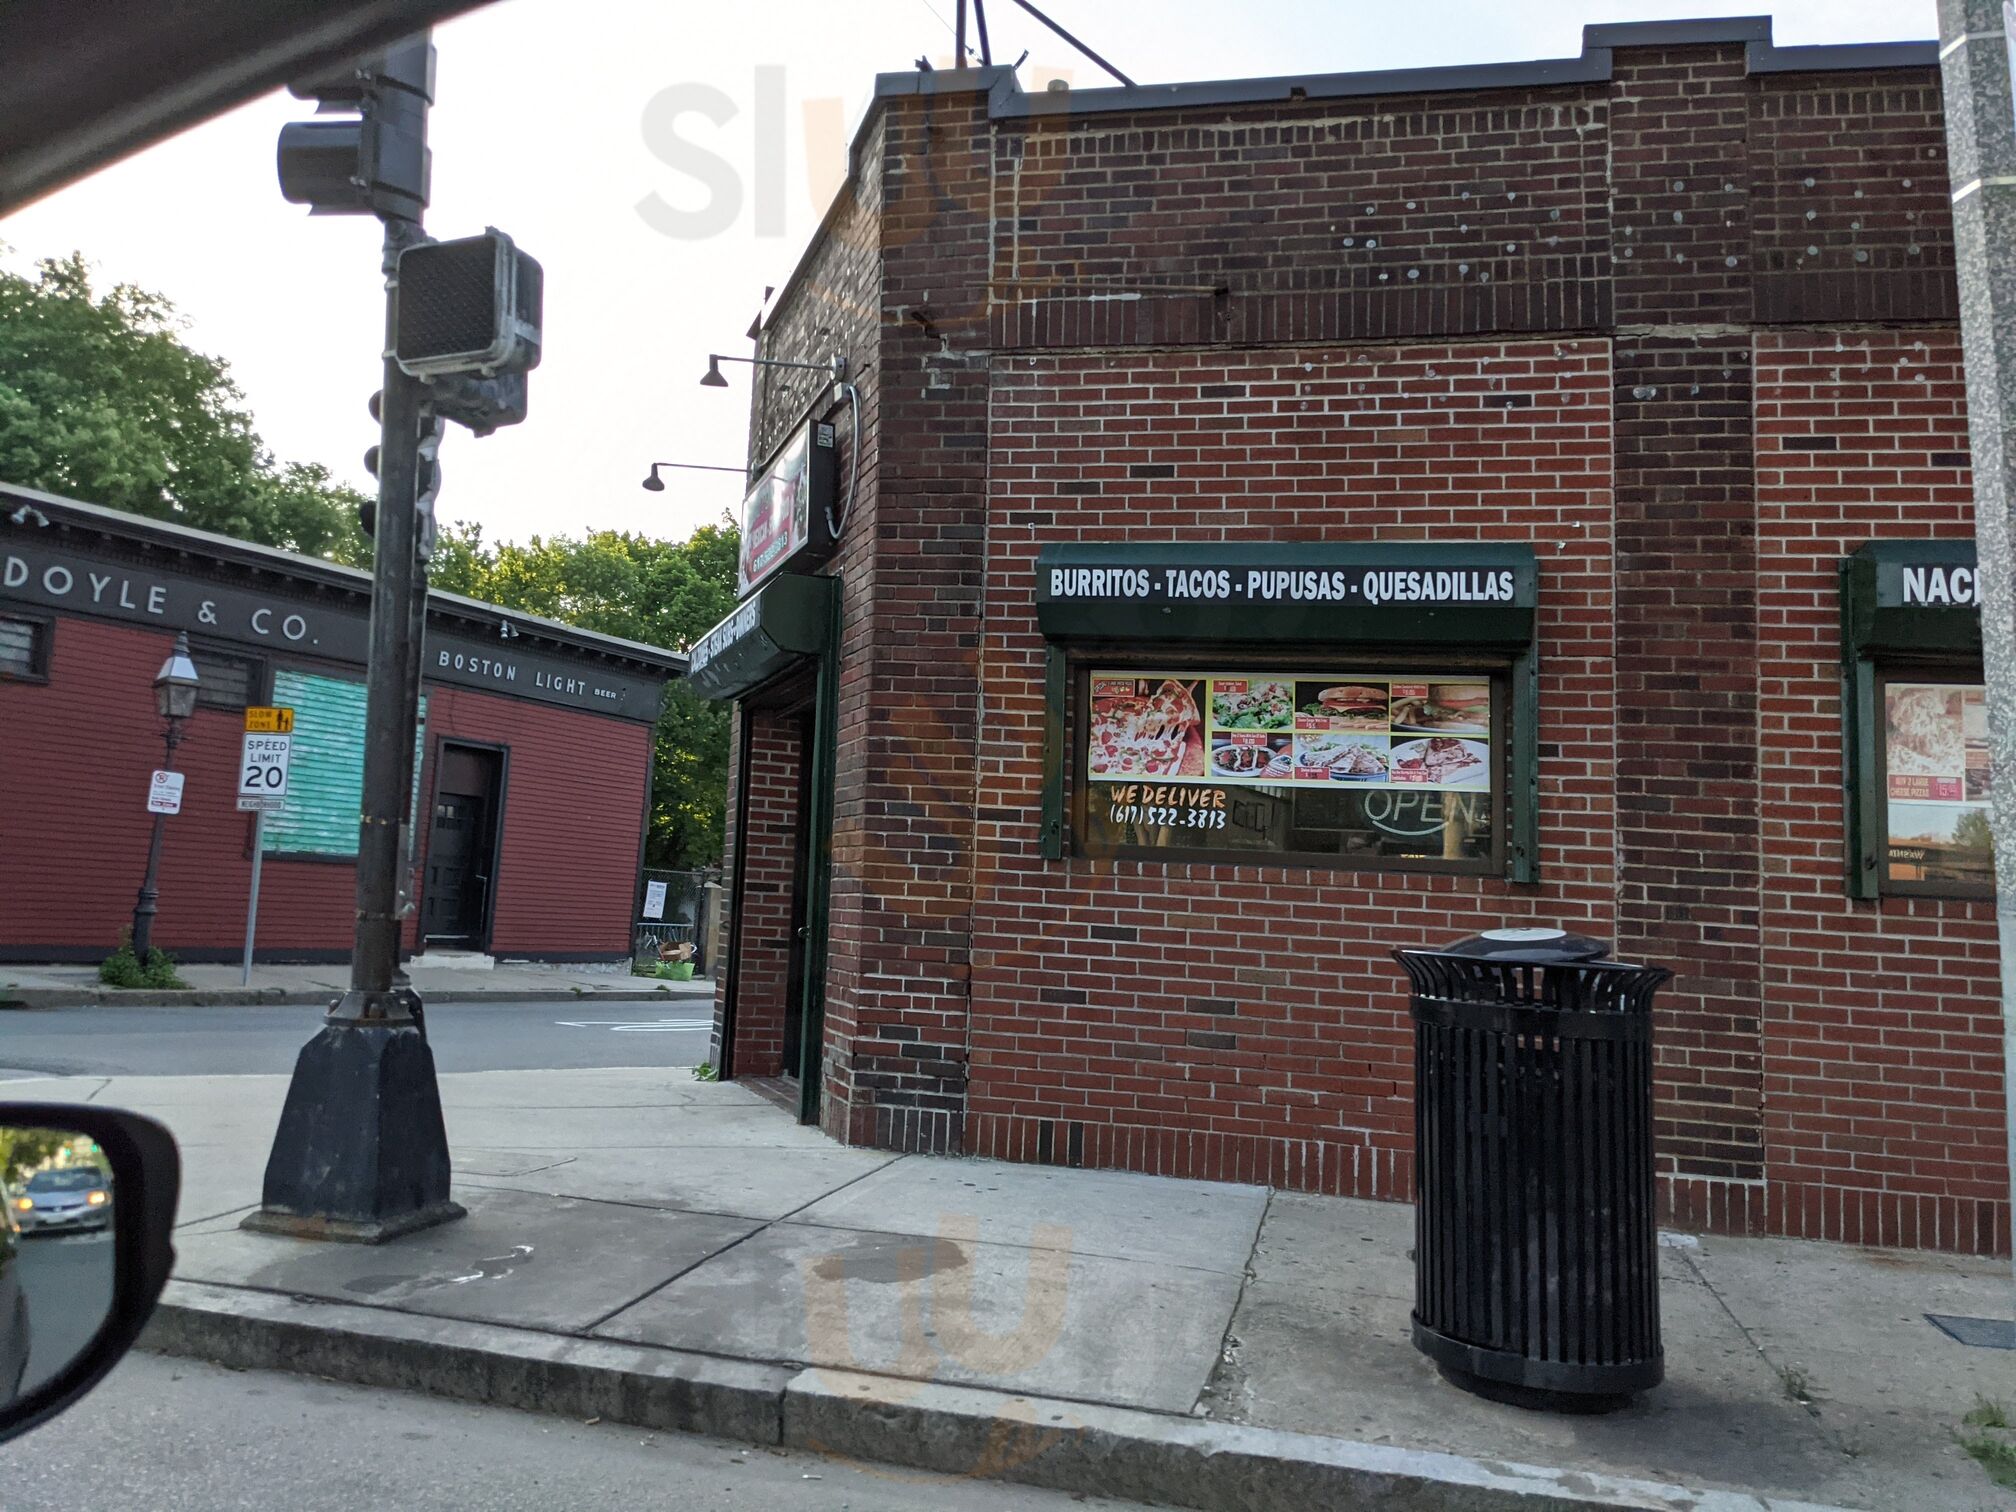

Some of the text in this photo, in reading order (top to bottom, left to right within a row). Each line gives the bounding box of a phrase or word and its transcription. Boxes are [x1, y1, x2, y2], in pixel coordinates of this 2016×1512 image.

[1051, 569, 1150, 597] BURRITOS
[1166, 570, 1230, 598] TACOS
[1248, 571, 1345, 600] PUPUSAS
[1363, 571, 1514, 605] QUESADILLAS
[3, 556, 318, 644] DOYLE & CO.
[438, 651, 616, 699] BOSTON LIGHT BEER
[248, 710, 272, 718] SLOW
[248, 740, 287, 751] SPEED
[250, 753, 281, 763] LIMIT
[245, 766, 283, 788] 20
[1111, 785, 1226, 808] WE DELIVER
[1364, 790, 1476, 823] OPEN
[1110, 805, 1227, 829] (617) 522-3813
